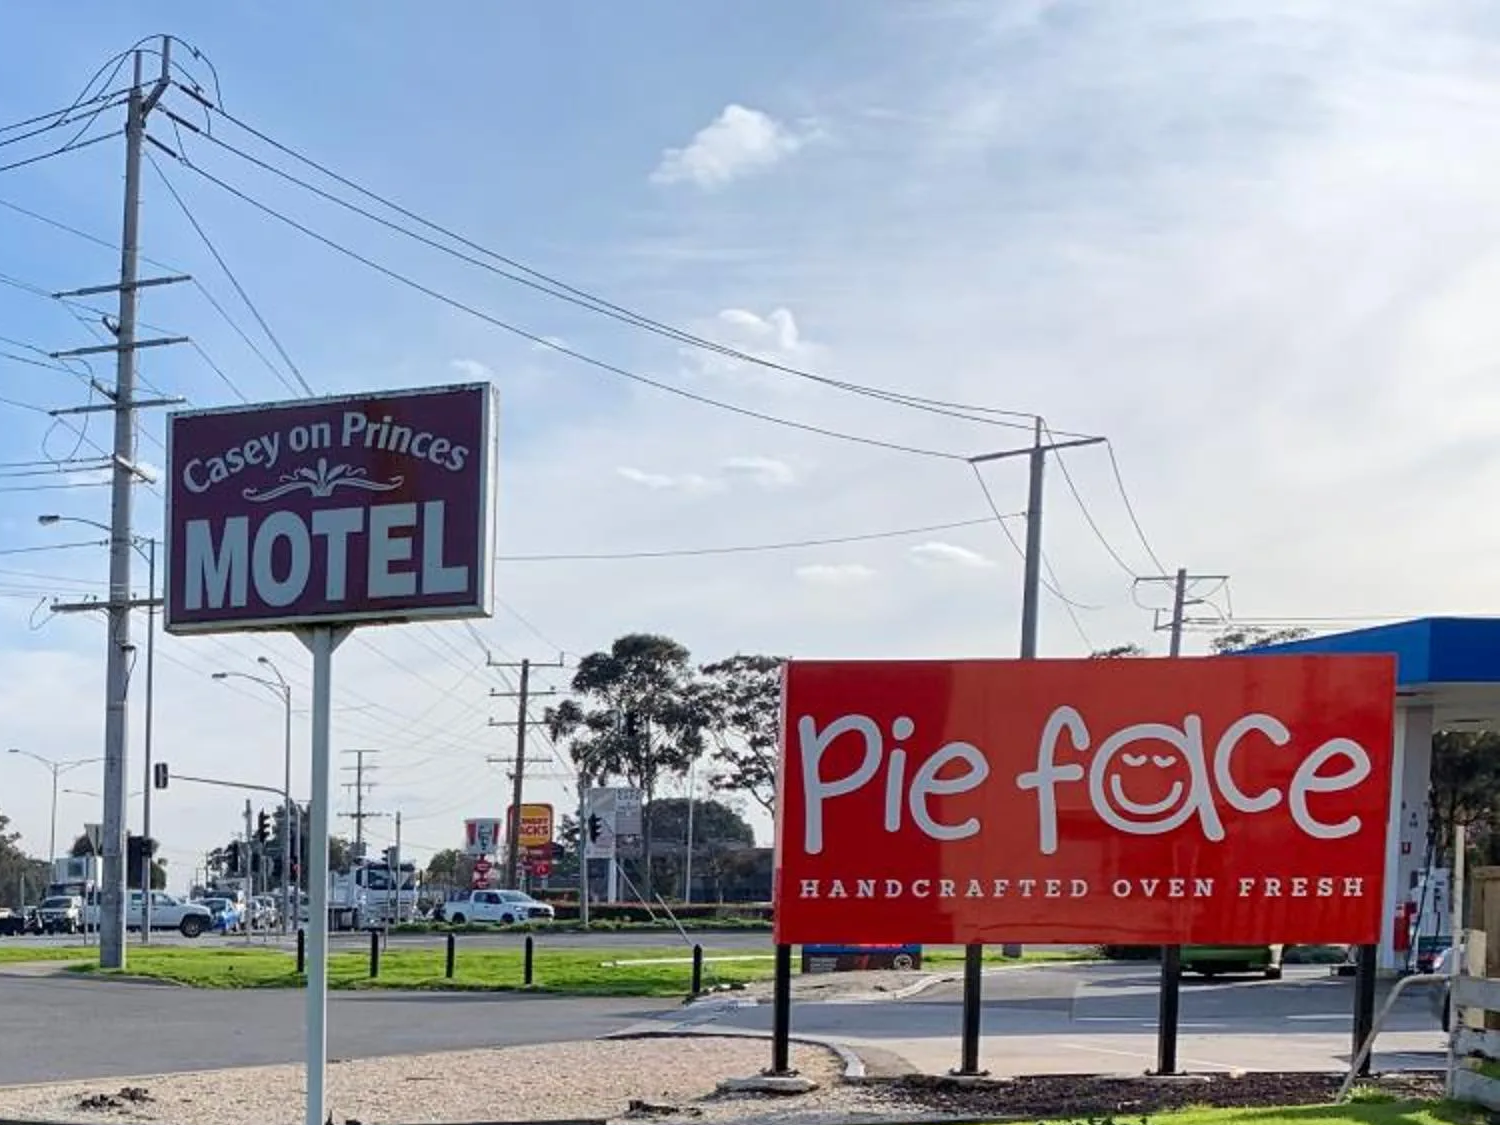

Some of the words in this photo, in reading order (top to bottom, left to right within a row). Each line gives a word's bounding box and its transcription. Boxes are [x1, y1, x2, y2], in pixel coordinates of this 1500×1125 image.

[183, 431, 280, 493] Casey
[289, 422, 331, 452] on
[342, 410, 469, 472] Princes
[185, 500, 469, 611] MOTEL
[1016, 705, 1371, 855] face
[800, 879, 1090, 900] HANDCRAFTED
[1112, 878, 1216, 898] OVEN
[1238, 876, 1366, 898] FRESH
